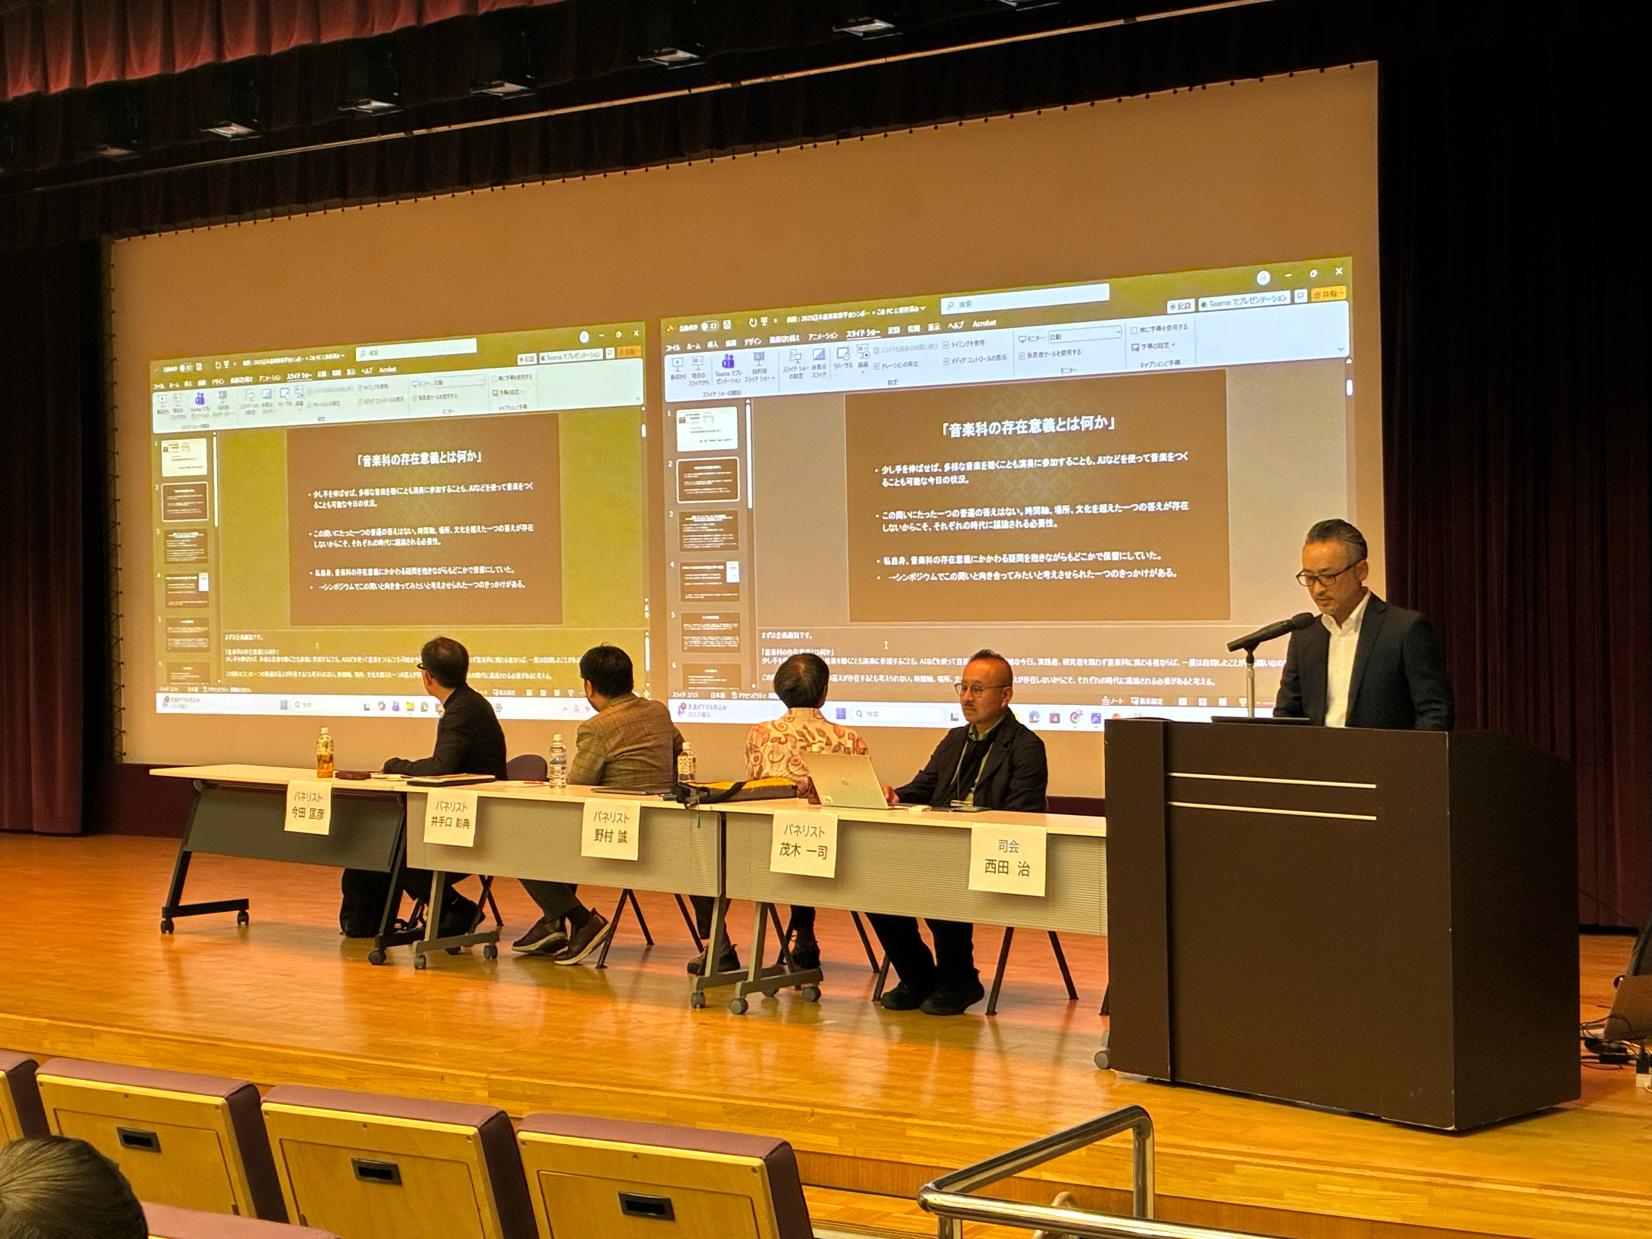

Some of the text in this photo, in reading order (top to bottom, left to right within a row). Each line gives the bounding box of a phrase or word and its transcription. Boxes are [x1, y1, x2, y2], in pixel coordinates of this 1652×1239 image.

[1210, 300, 1231, 308] Teams
[972, 320, 996, 328] Acrobat
[943, 416, 1116, 438] 「音楽科の存在意義とは何か」
[357, 450, 482, 468] 「音楽科の存在意義とは何か」
[294, 792, 323, 804] パネリスト
[291, 806, 306, 819] 今田
[436, 800, 468, 814] パネリスト
[430, 816, 452, 828] 井手口
[593, 812, 630, 824] パネリスト
[594, 828, 628, 844] 野村 誠
[784, 824, 825, 839] パネリスト
[779, 842, 828, 860] 茂木 一司
[998, 839, 1020, 854] 司会
[984, 858, 1030, 877] 西田 治
